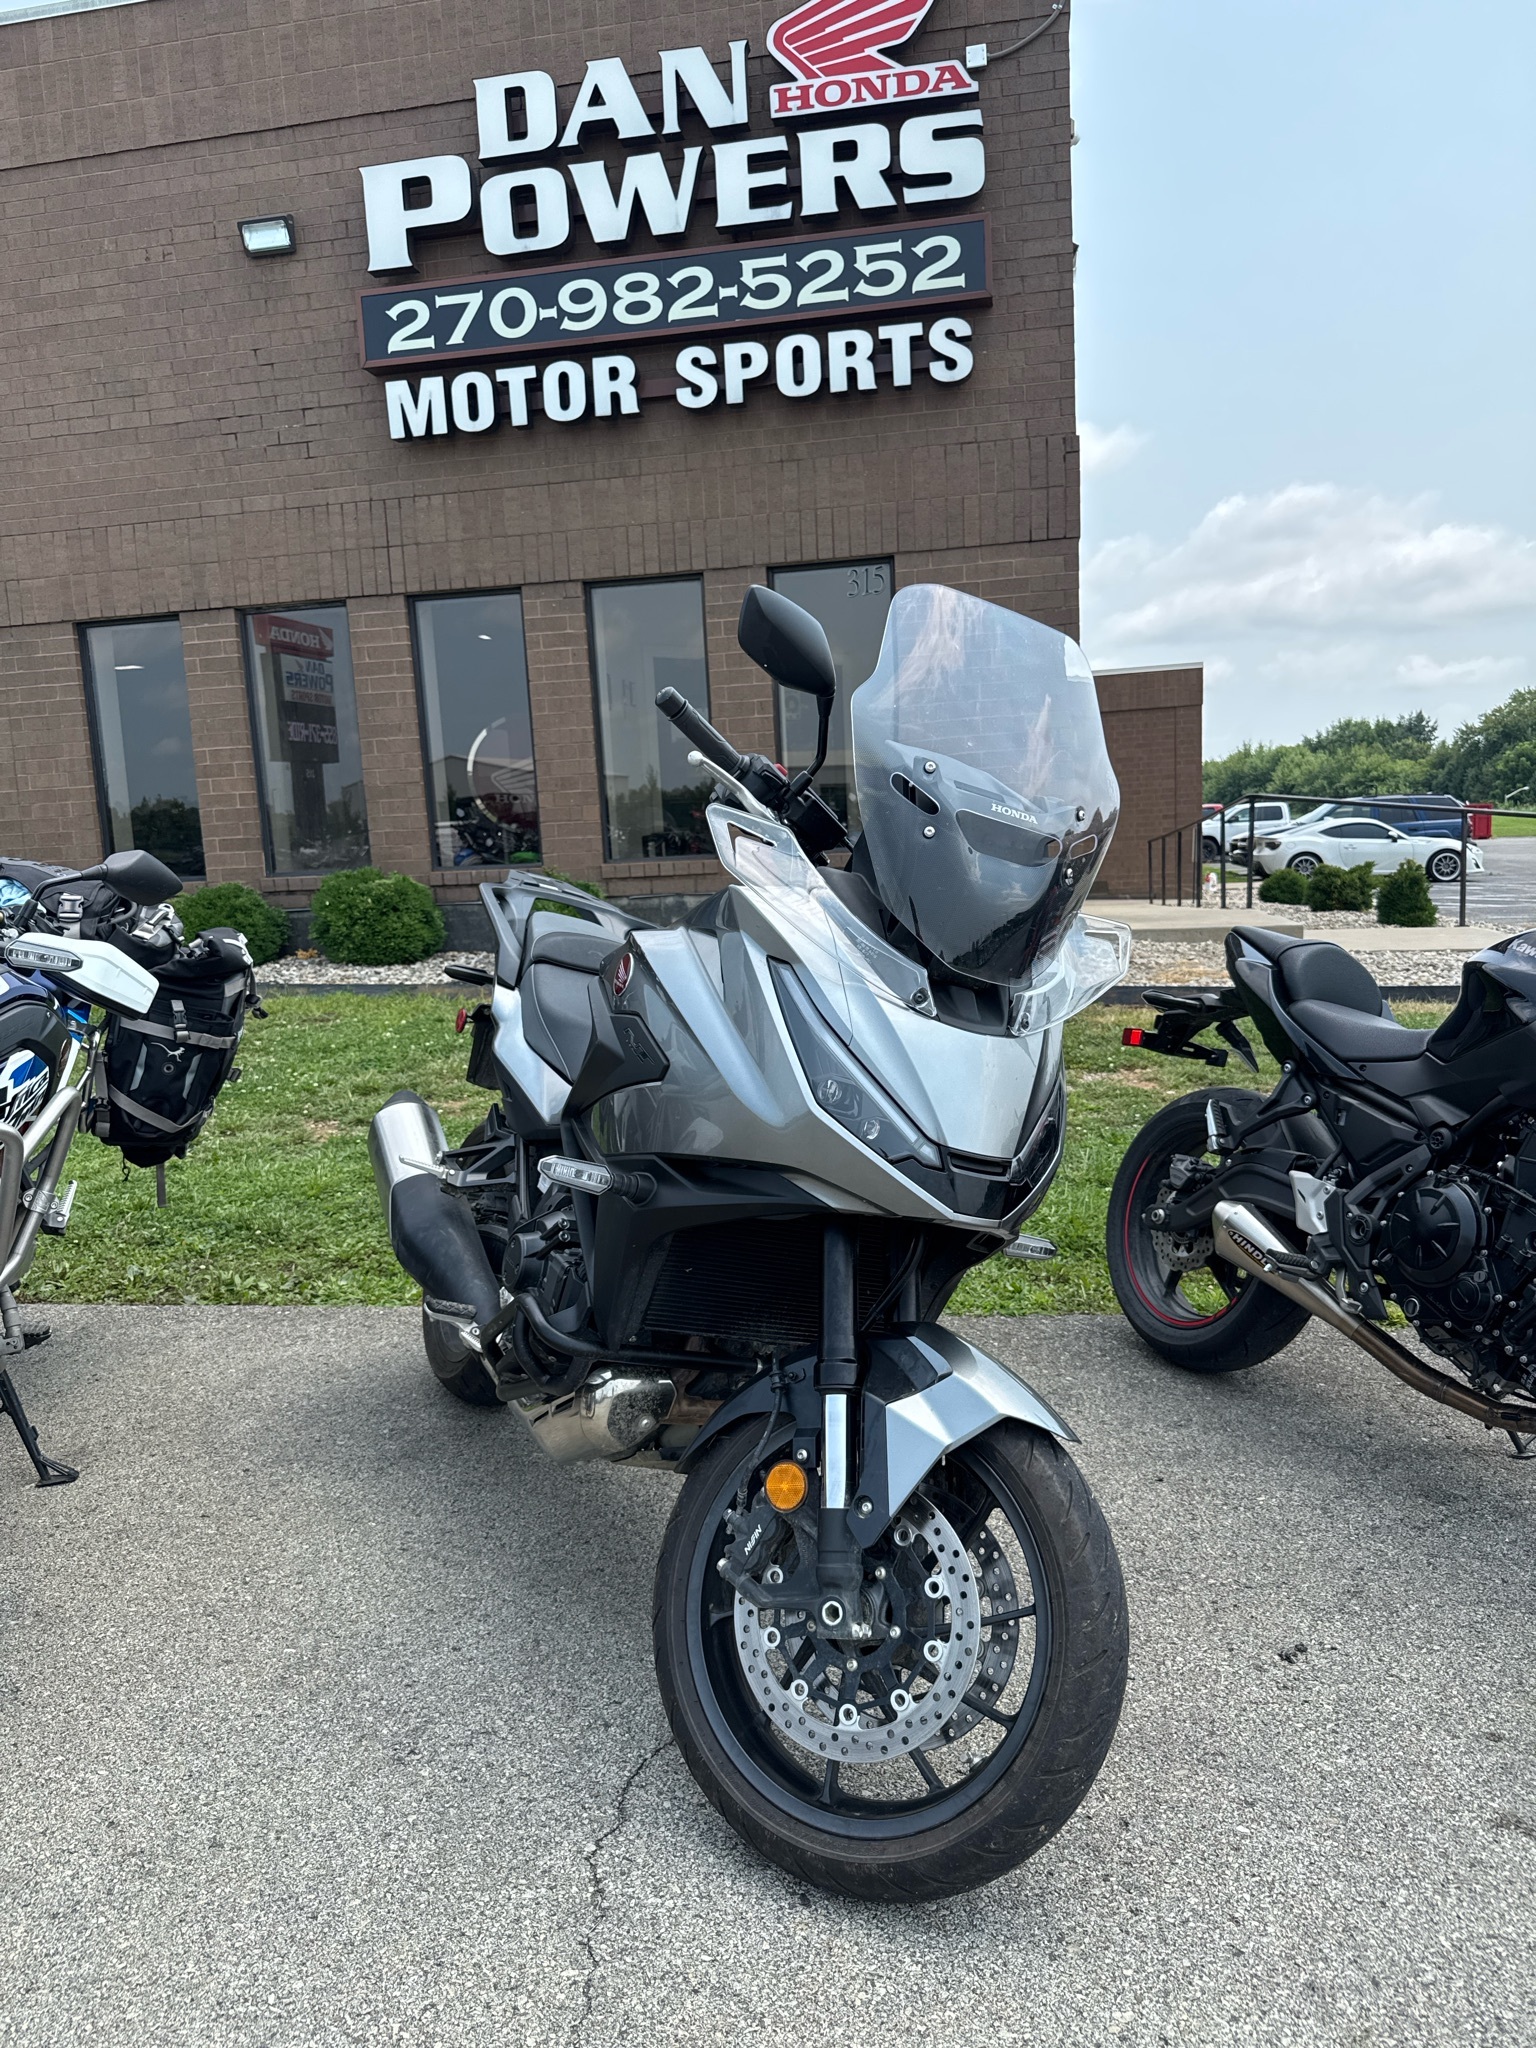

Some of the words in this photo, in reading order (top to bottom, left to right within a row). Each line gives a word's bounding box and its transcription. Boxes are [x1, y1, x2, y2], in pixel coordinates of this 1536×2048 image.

[473, 39, 749, 163] DAN
[773, 64, 972, 114] HONDA
[359, 109, 986, 273] POWERS
[386, 235, 966, 354] 270-982-5252
[385, 354, 641, 440] MOTOR
[674, 317, 974, 410] SPORTS
[847, 565, 885, 598] 315
[991, 803, 1039, 825] HONDA
[1507, 938, 1536, 958] Kaw
[1232, 1233, 1268, 1266] HINDL
